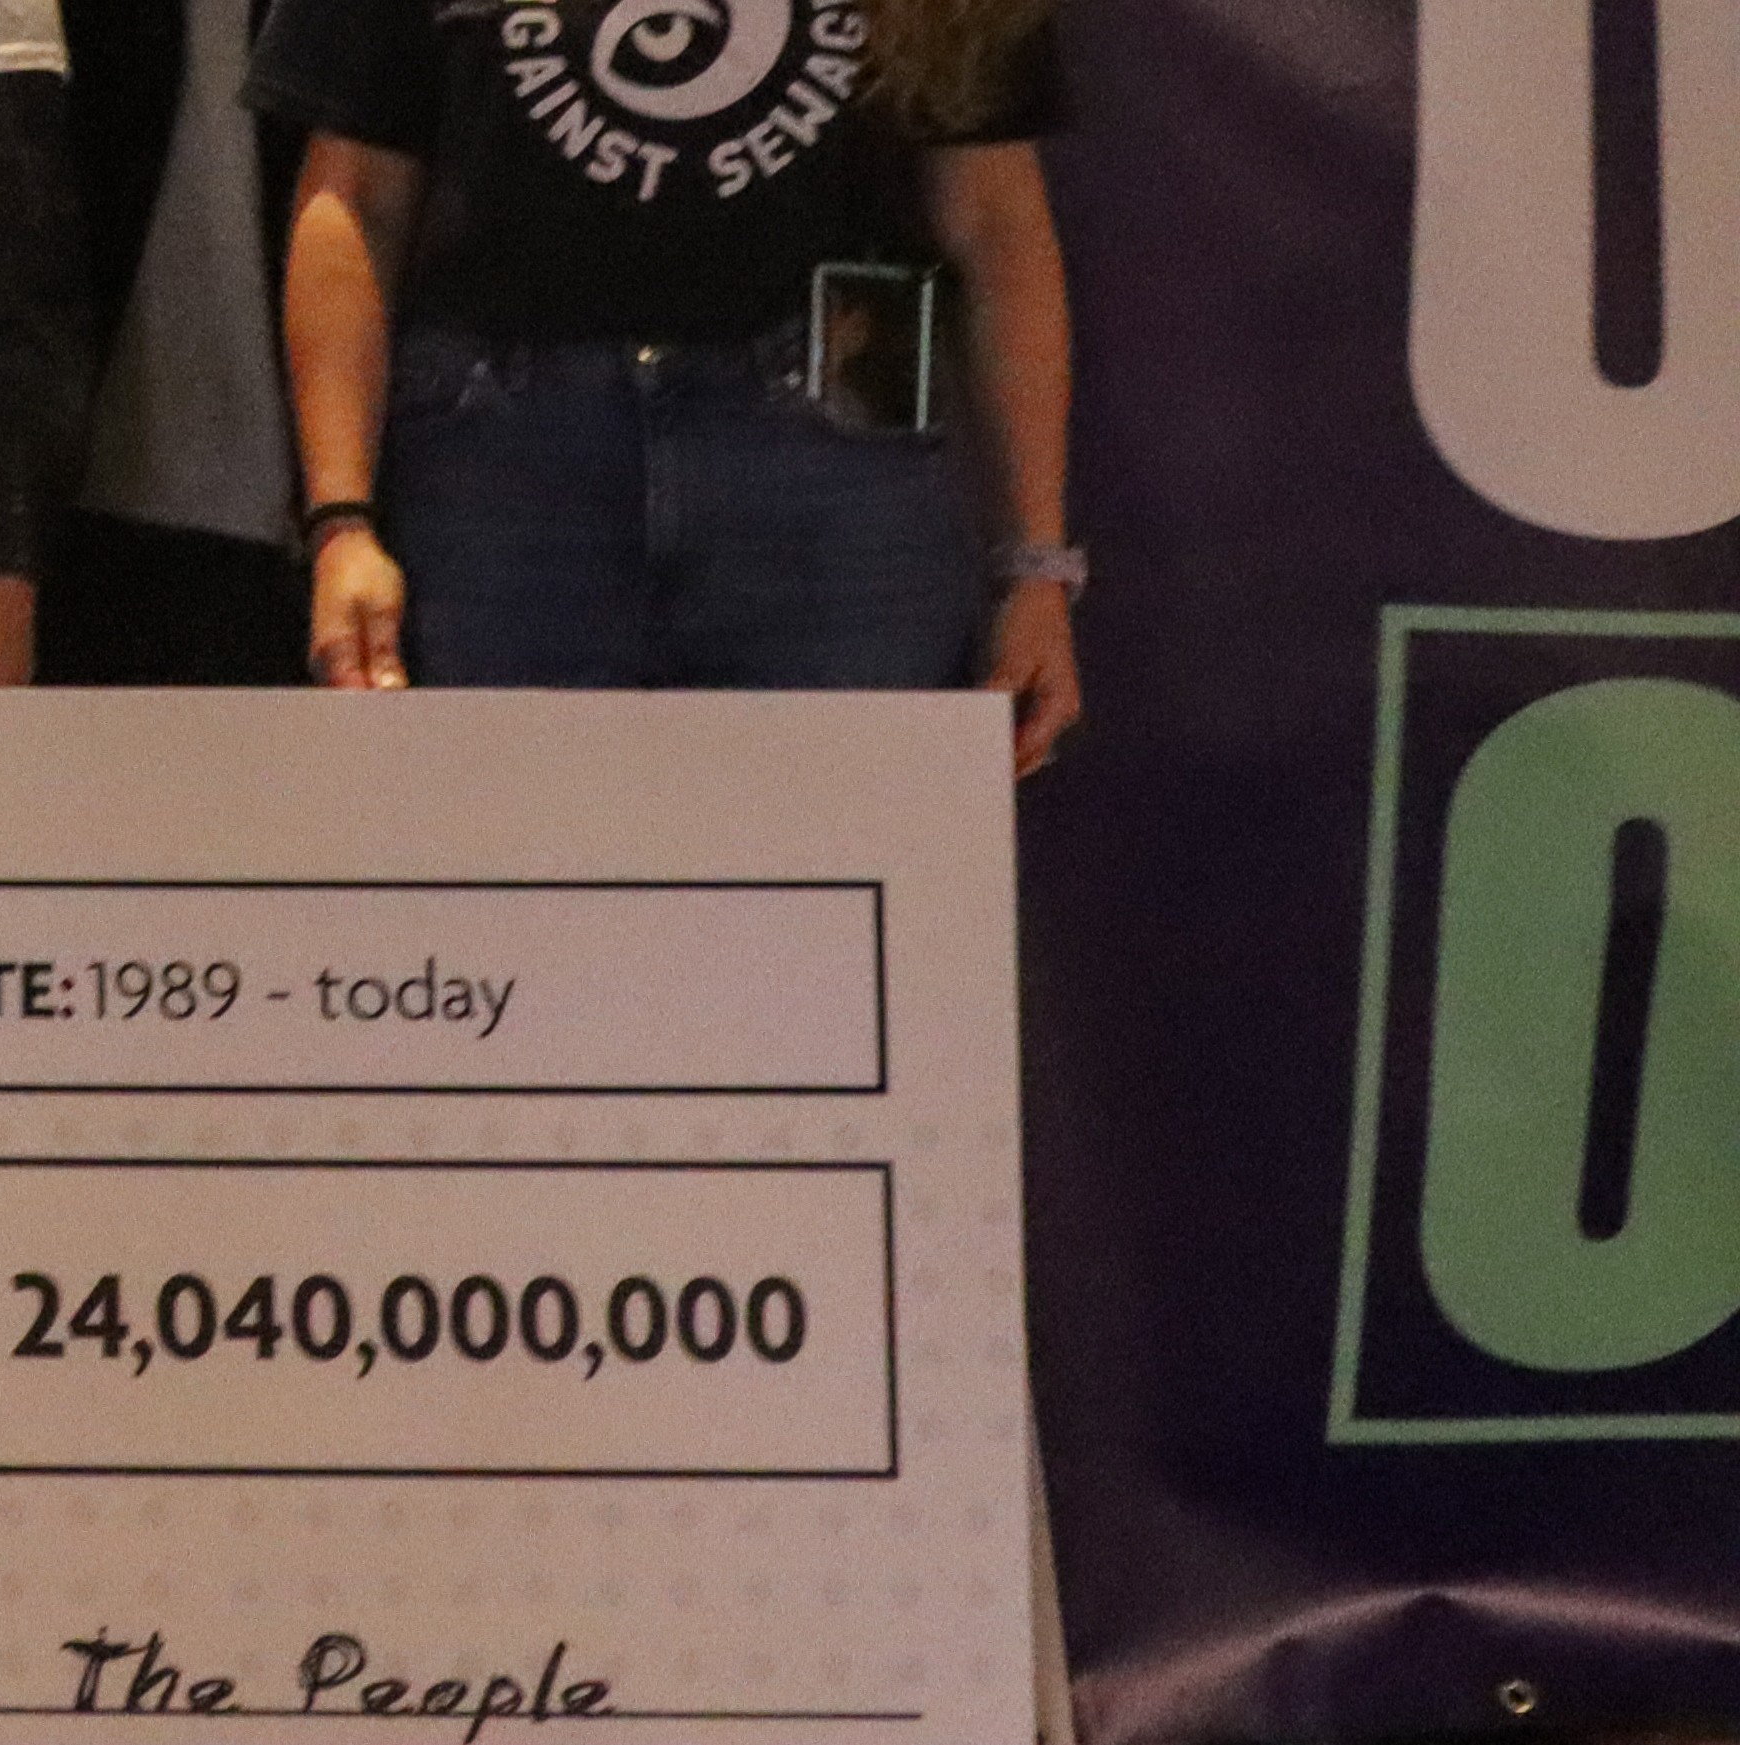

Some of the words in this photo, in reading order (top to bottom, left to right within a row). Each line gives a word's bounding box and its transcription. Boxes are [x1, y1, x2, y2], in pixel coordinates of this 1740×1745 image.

[314, 956, 517, 1040] today
[11, 1273, 807, 1380] 24,040,000,000
[60, 1627, 240, 1715] The
[297, 1634, 616, 1742] People
